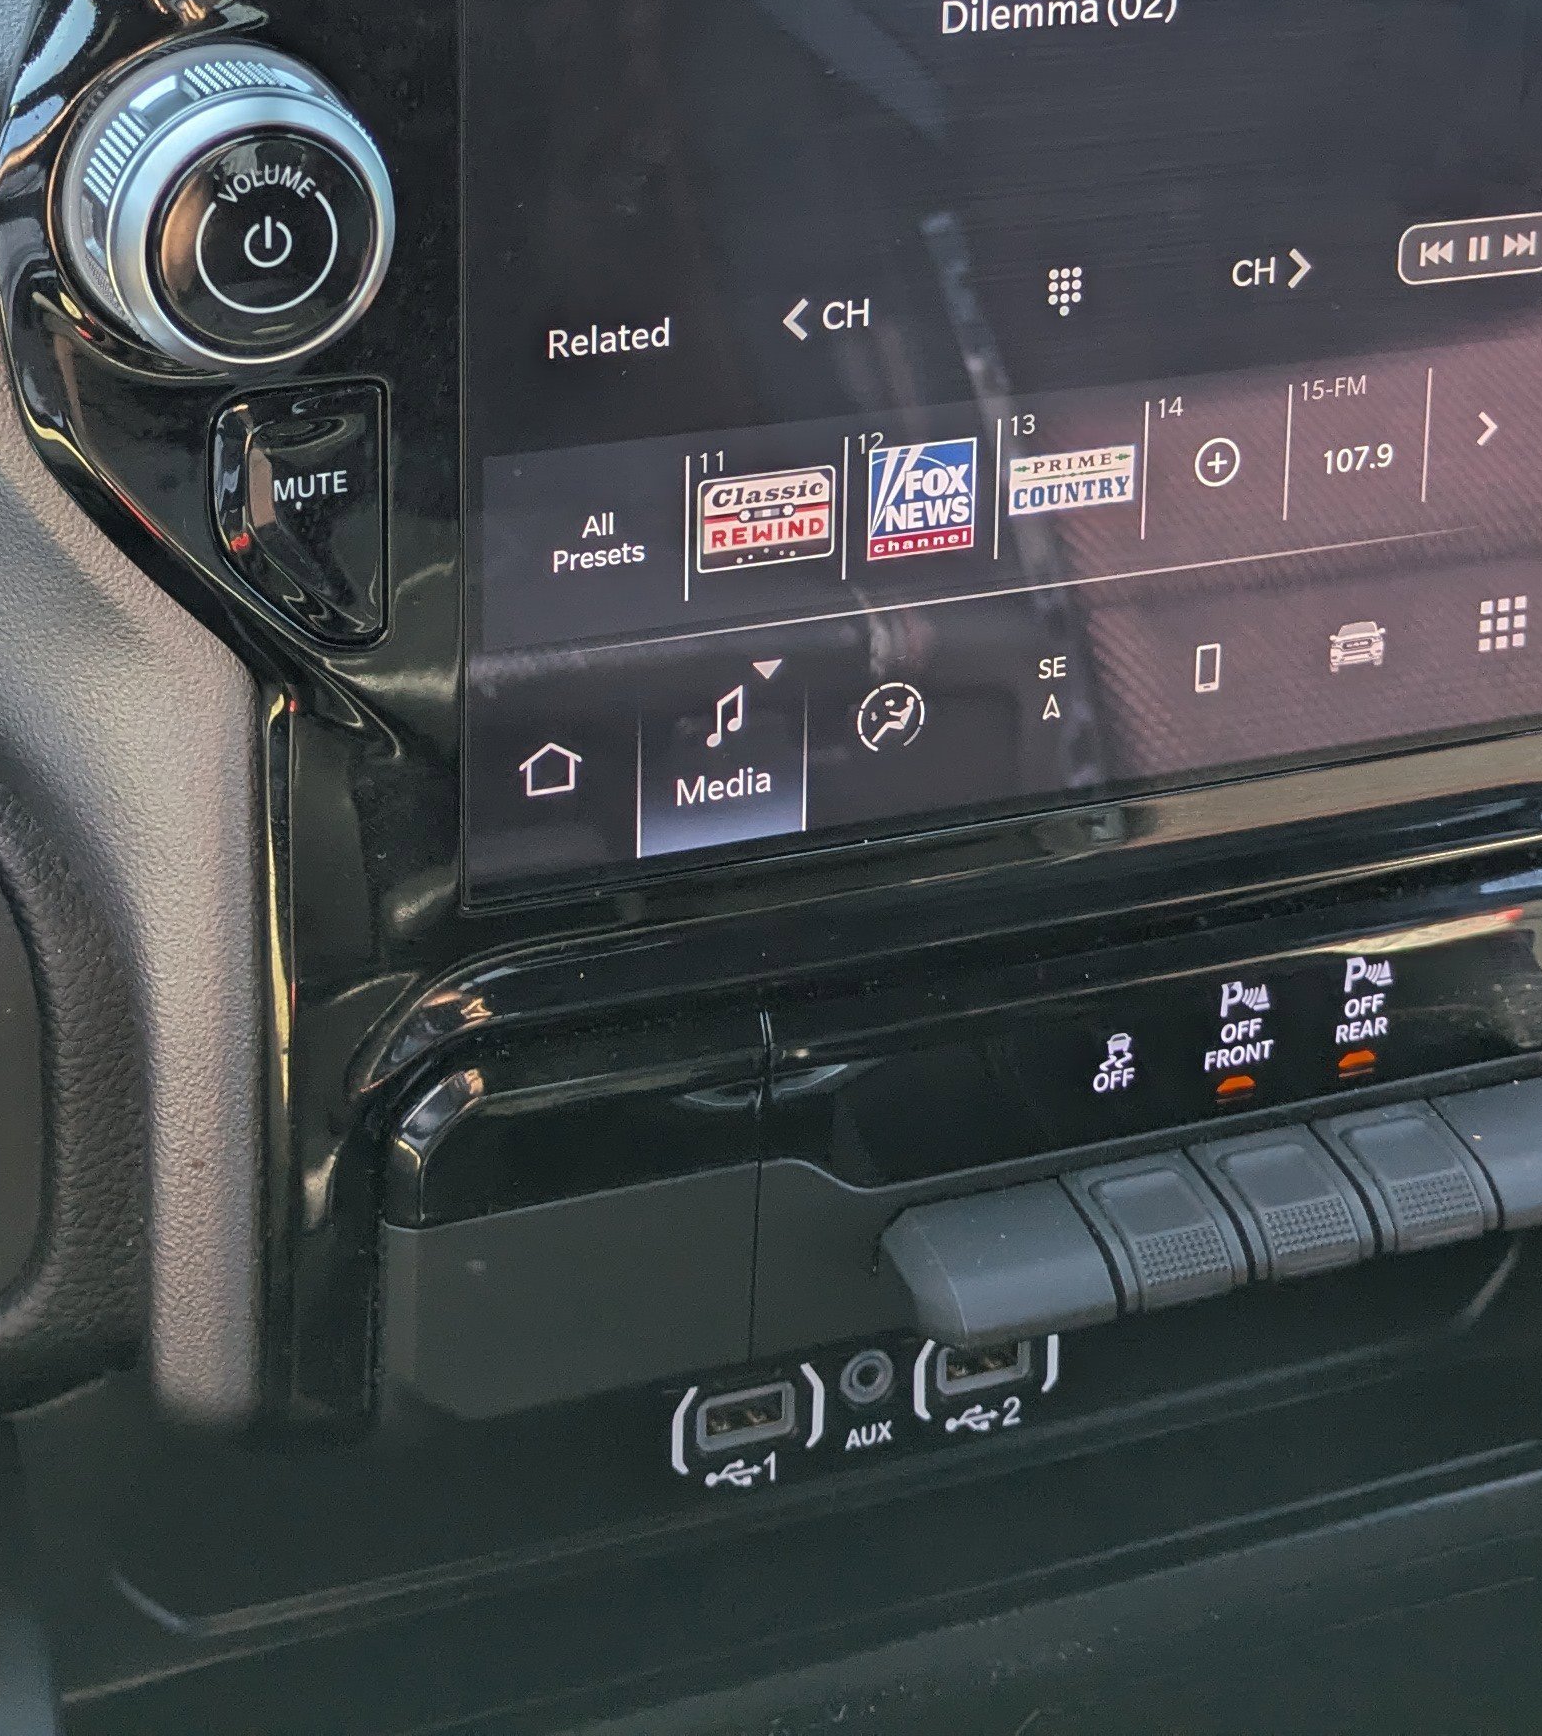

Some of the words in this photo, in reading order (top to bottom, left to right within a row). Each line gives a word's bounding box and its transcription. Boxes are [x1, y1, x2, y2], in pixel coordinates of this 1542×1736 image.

[217, 164, 317, 204] VOLUME
[1232, 257, 1275, 287] CH
[822, 298, 870, 331] CH
[548, 317, 670, 359] Related
[1301, 375, 1367, 401] 15-FM
[1158, 397, 1184, 418] 14
[1010, 414, 1036, 436] 13
[858, 432, 884, 454] 12
[699, 451, 725, 473] 11
[1033, 452, 1113, 474] PRIME
[1323, 443, 1394, 475] 107.9
[274, 470, 348, 501] MUTE
[711, 480, 824, 509] Classic
[904, 464, 969, 501] FOX
[1013, 475, 1130, 511] COUNTRY
[582, 512, 614, 539] All
[884, 495, 970, 533] NEWS
[711, 517, 825, 549] REWIND
[873, 529, 971, 556] channel
[553, 542, 645, 573] Presets
[1039, 656, 1067, 680] SE
[675, 766, 773, 807] Media
[1344, 993, 1385, 1020] OFF
[1220, 1017, 1262, 1044] OFF
[1335, 1017, 1388, 1044] REAR
[1204, 1039, 1274, 1072] FRONT
[1092, 1067, 1135, 1094] OFF
[1002, 1396, 1021, 1426] 2
[846, 1420, 893, 1451] AUX
[764, 1451, 776, 1482] 1
